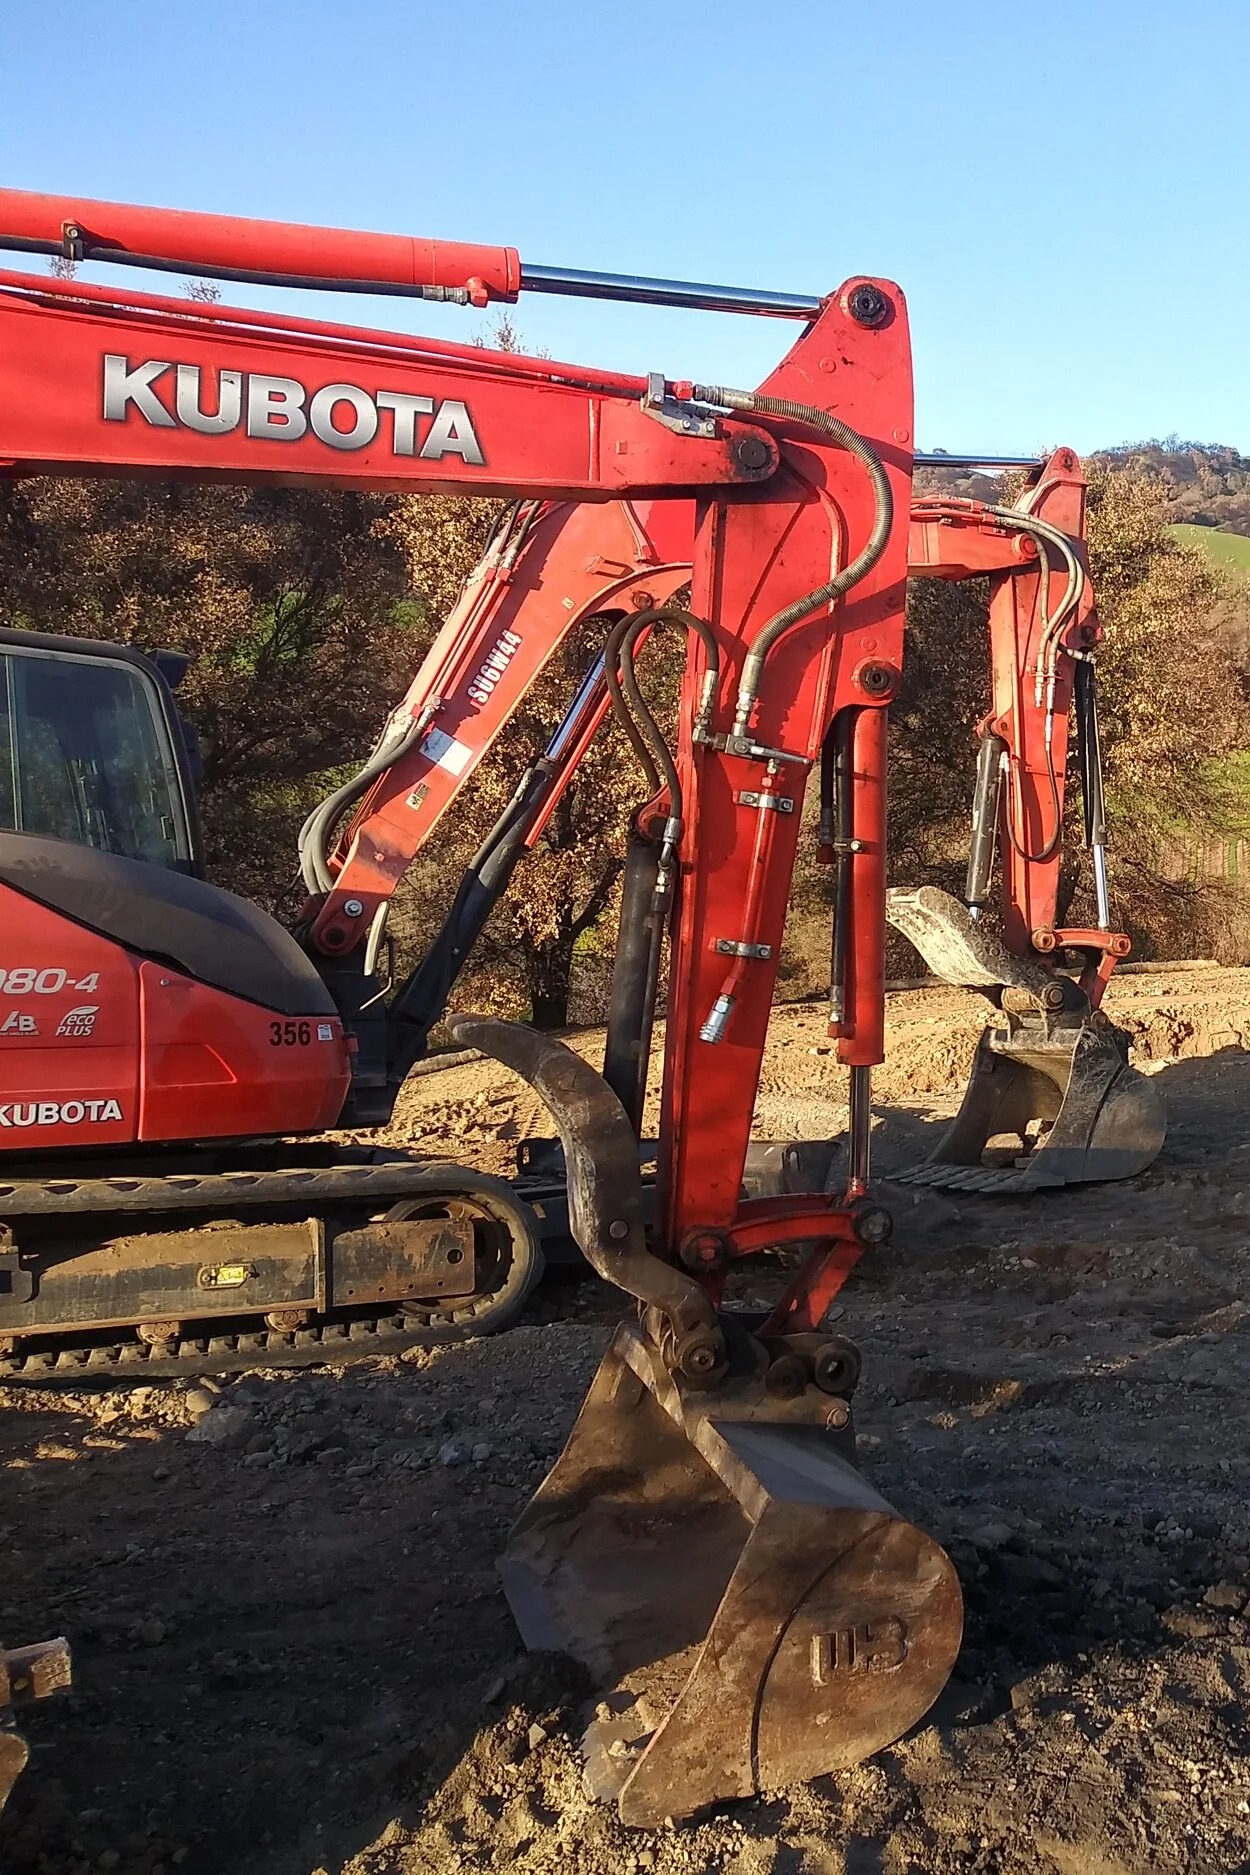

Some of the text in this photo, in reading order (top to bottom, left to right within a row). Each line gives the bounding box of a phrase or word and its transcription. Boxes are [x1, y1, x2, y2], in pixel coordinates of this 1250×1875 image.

[103, 354, 485, 465] KUBOTA
[467, 629, 522, 703] SU6W44
[0, 968, 100, 993] 80-4
[55, 1025, 93, 1037] PLUS
[66, 1014, 96, 1026] eco
[269, 1021, 311, 1046] 356
